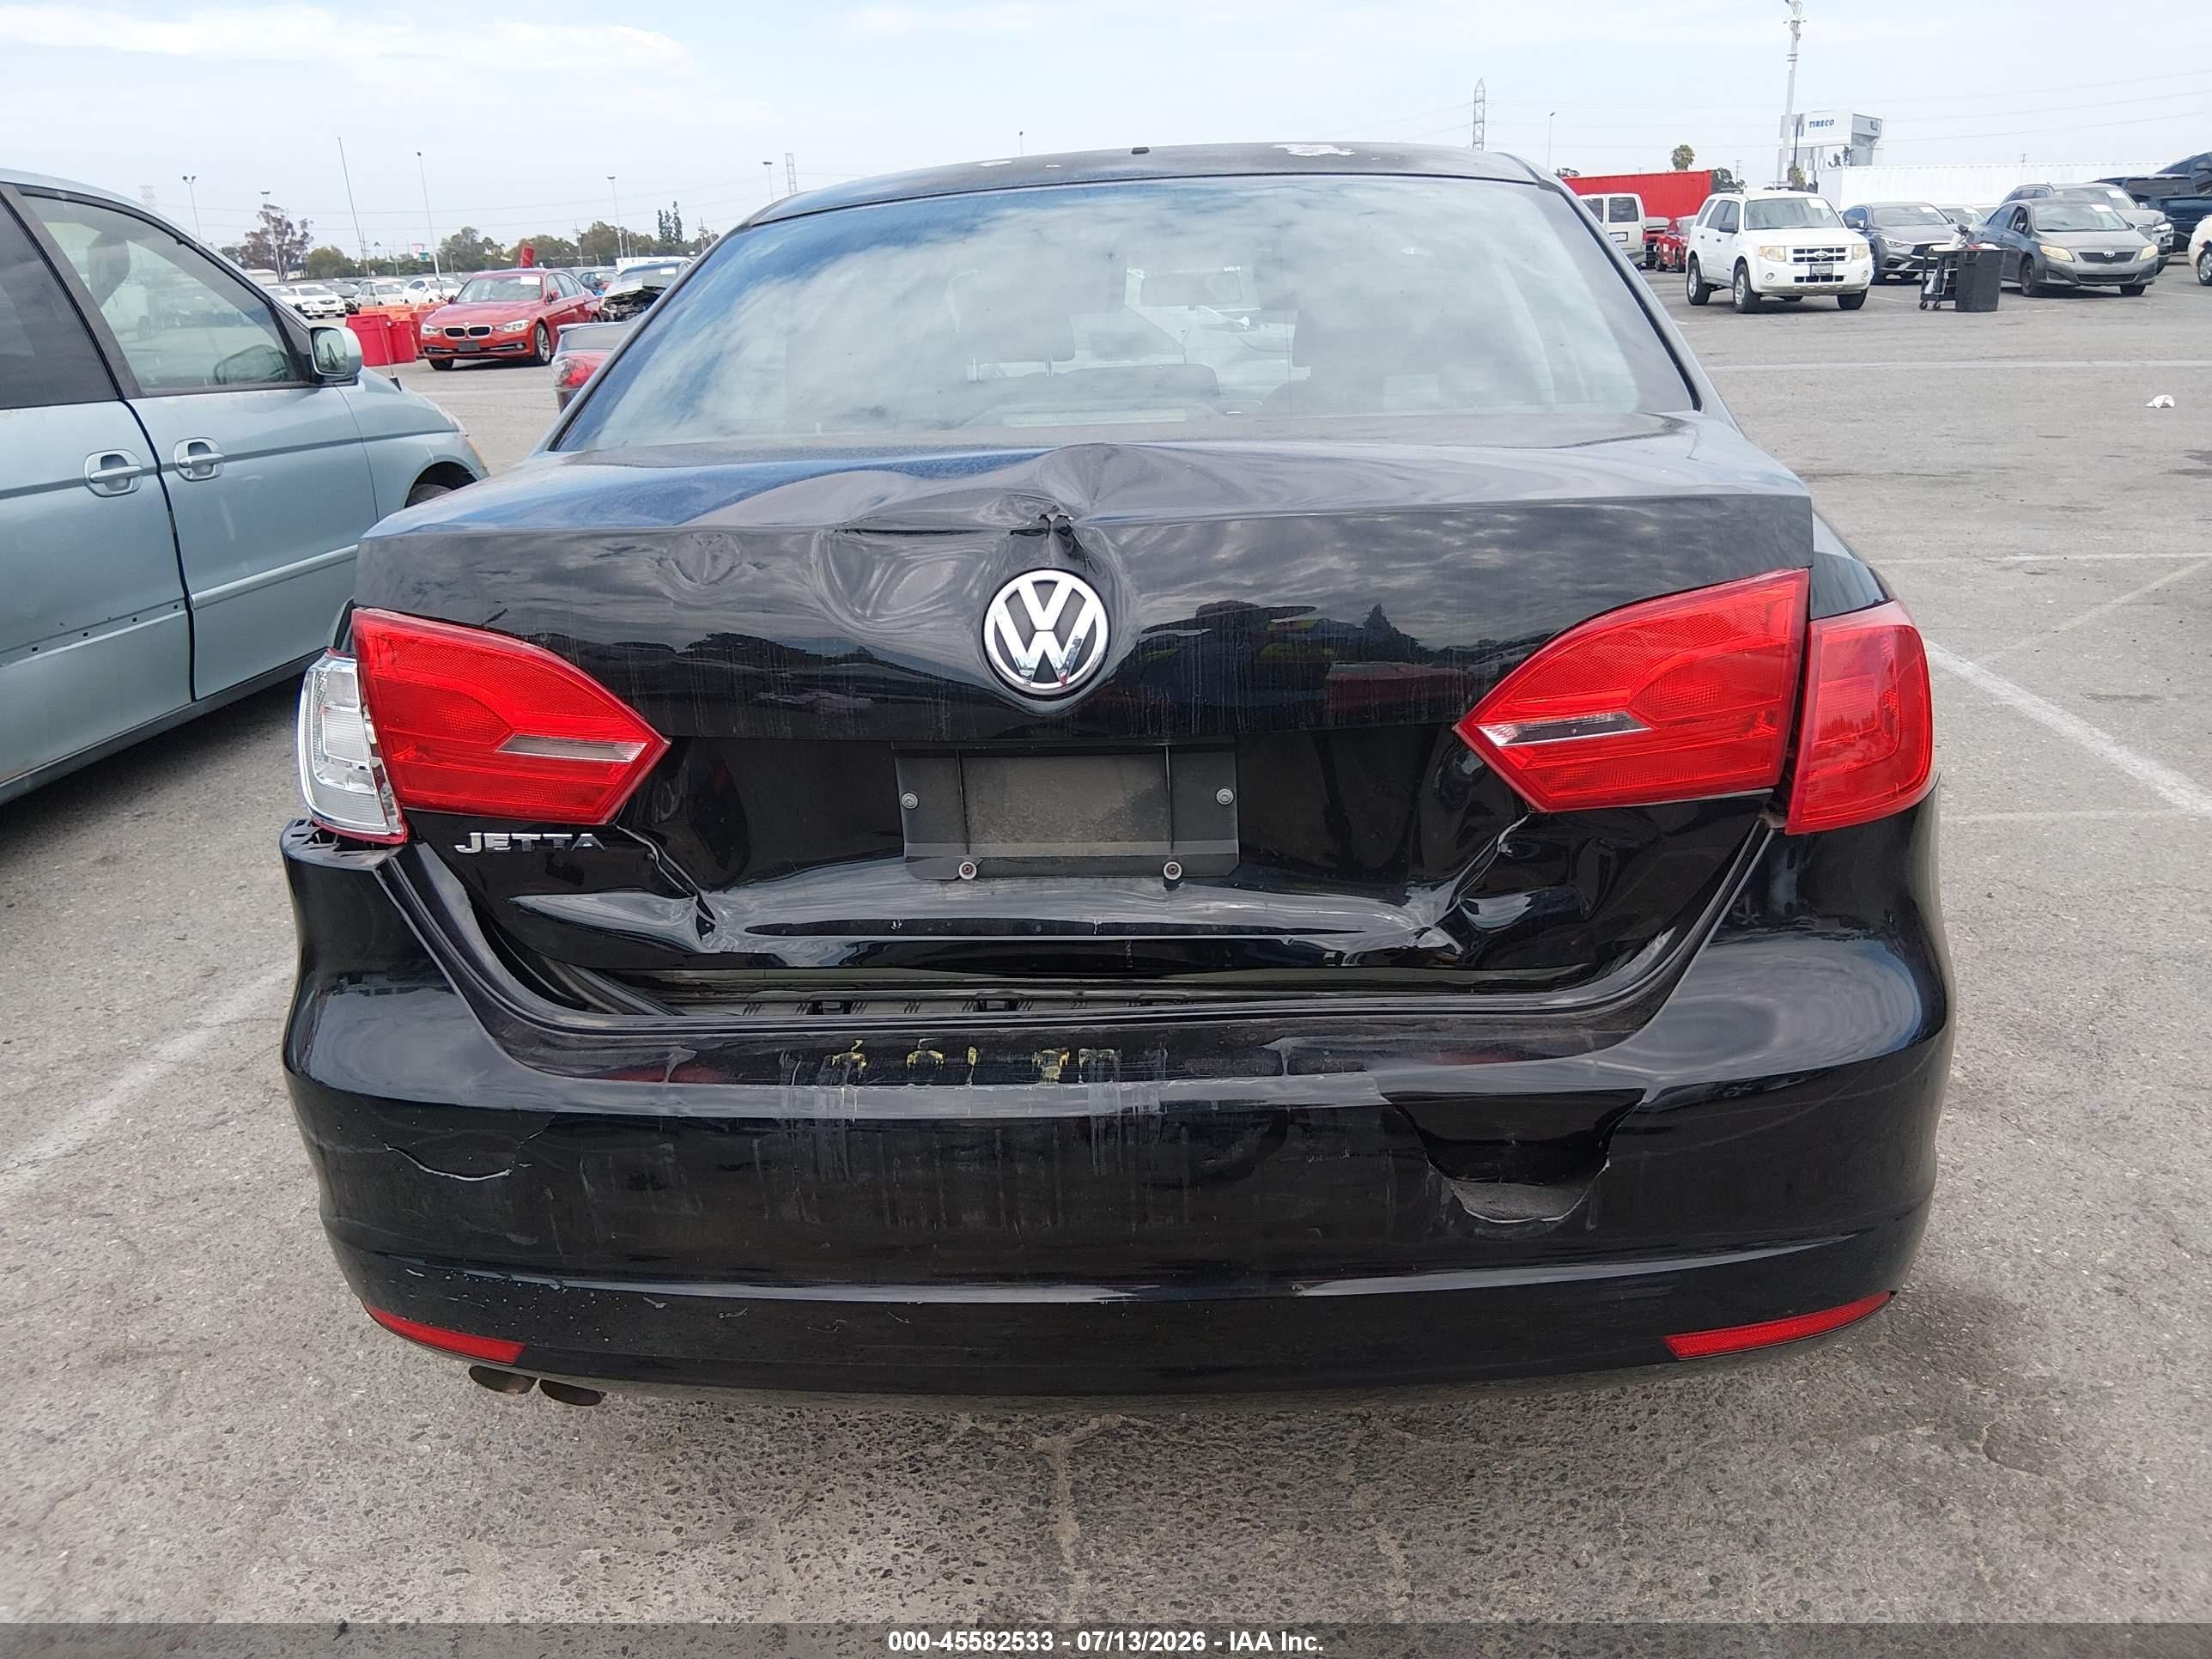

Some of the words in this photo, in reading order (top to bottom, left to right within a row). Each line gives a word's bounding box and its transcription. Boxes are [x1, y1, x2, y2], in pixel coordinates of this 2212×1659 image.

[1808, 118, 1834, 128] TIRECO
[991, 572, 1099, 687] VW
[454, 832, 606, 854] JETTA
